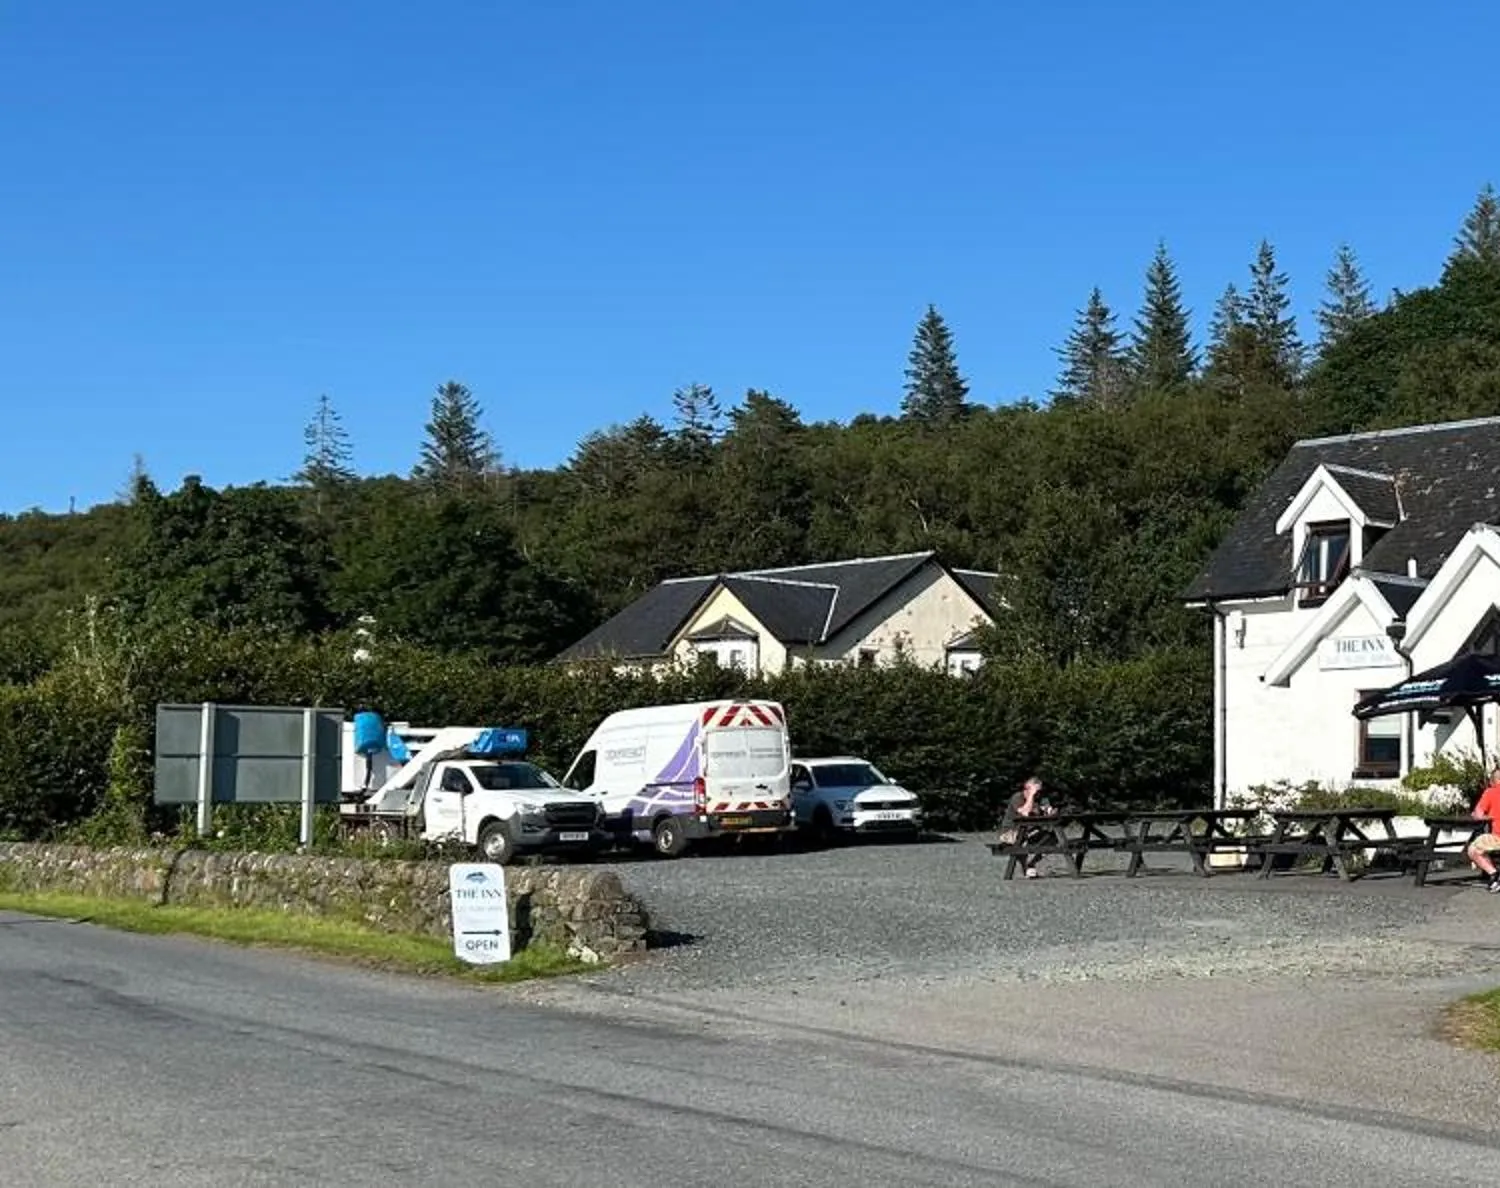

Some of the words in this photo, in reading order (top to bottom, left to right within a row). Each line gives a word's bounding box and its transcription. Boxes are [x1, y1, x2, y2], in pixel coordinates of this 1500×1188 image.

[1335, 639, 1360, 653] THE
[1362, 638, 1385, 651] INN
[455, 888, 479, 899] THE
[481, 888, 502, 898] INN
[465, 939, 499, 951] OPEN
